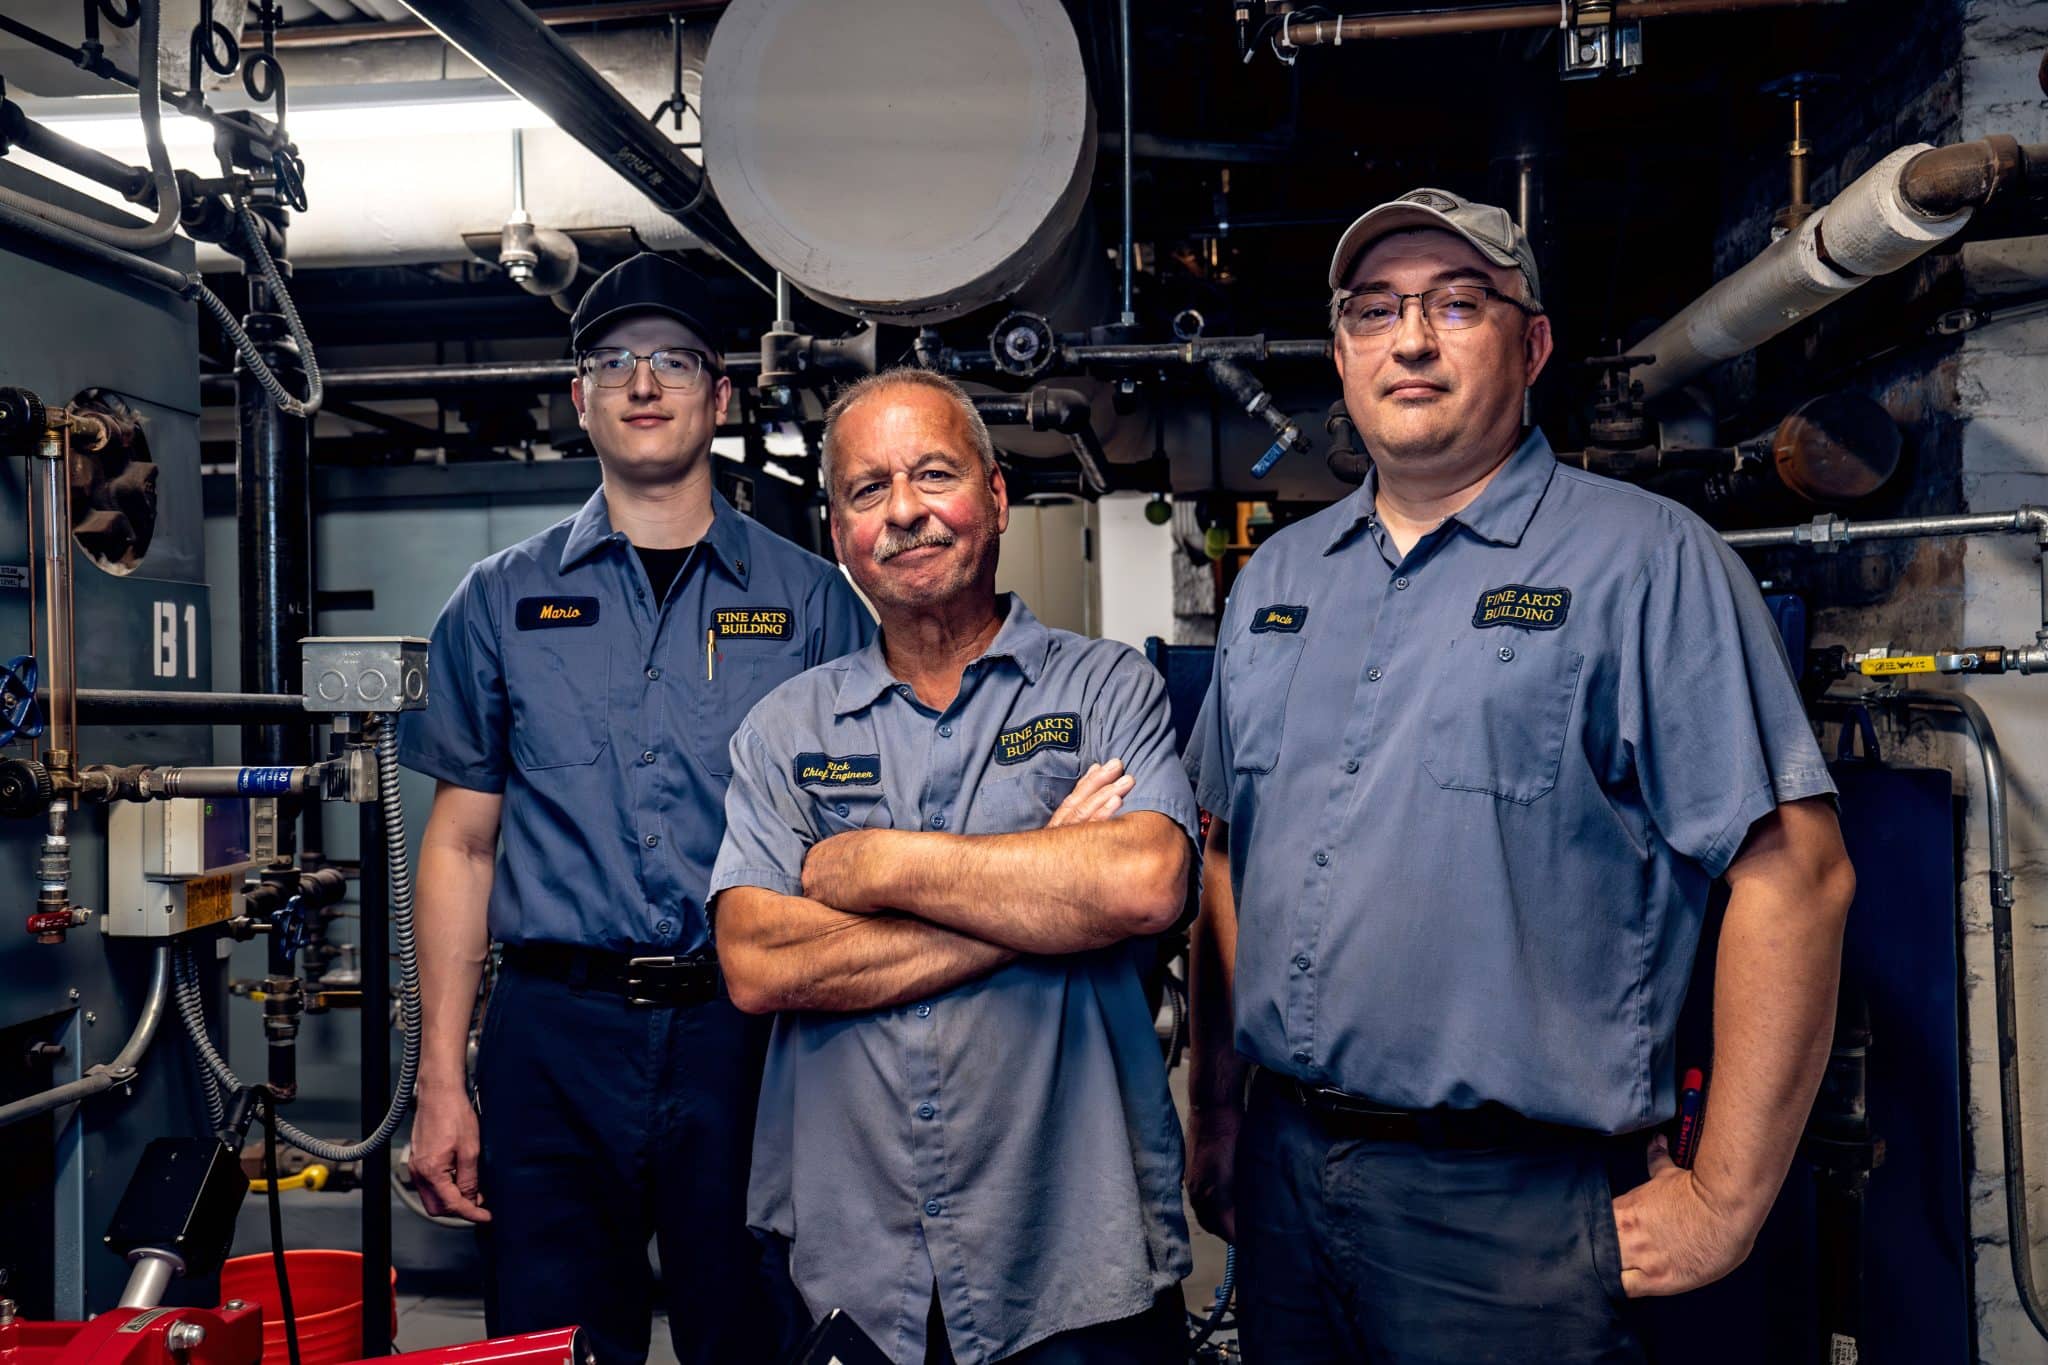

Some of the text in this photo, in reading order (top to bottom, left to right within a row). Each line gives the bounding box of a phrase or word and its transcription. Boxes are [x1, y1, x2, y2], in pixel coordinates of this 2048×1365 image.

[1485, 590, 1562, 607] FINE ARTS
[540, 604, 581, 619] Mario
[716, 612, 787, 623] FINE ARTS
[1483, 605, 1554, 622] BUILDING
[721, 623, 783, 635] BUILDING
[154, 601, 196, 678] B1
[1000, 717, 1074, 746] FINE ARTS
[1006, 731, 1069, 758] BUILDING
[826, 761, 851, 771] Rick
[802, 767, 874, 782] Chief Engineer
